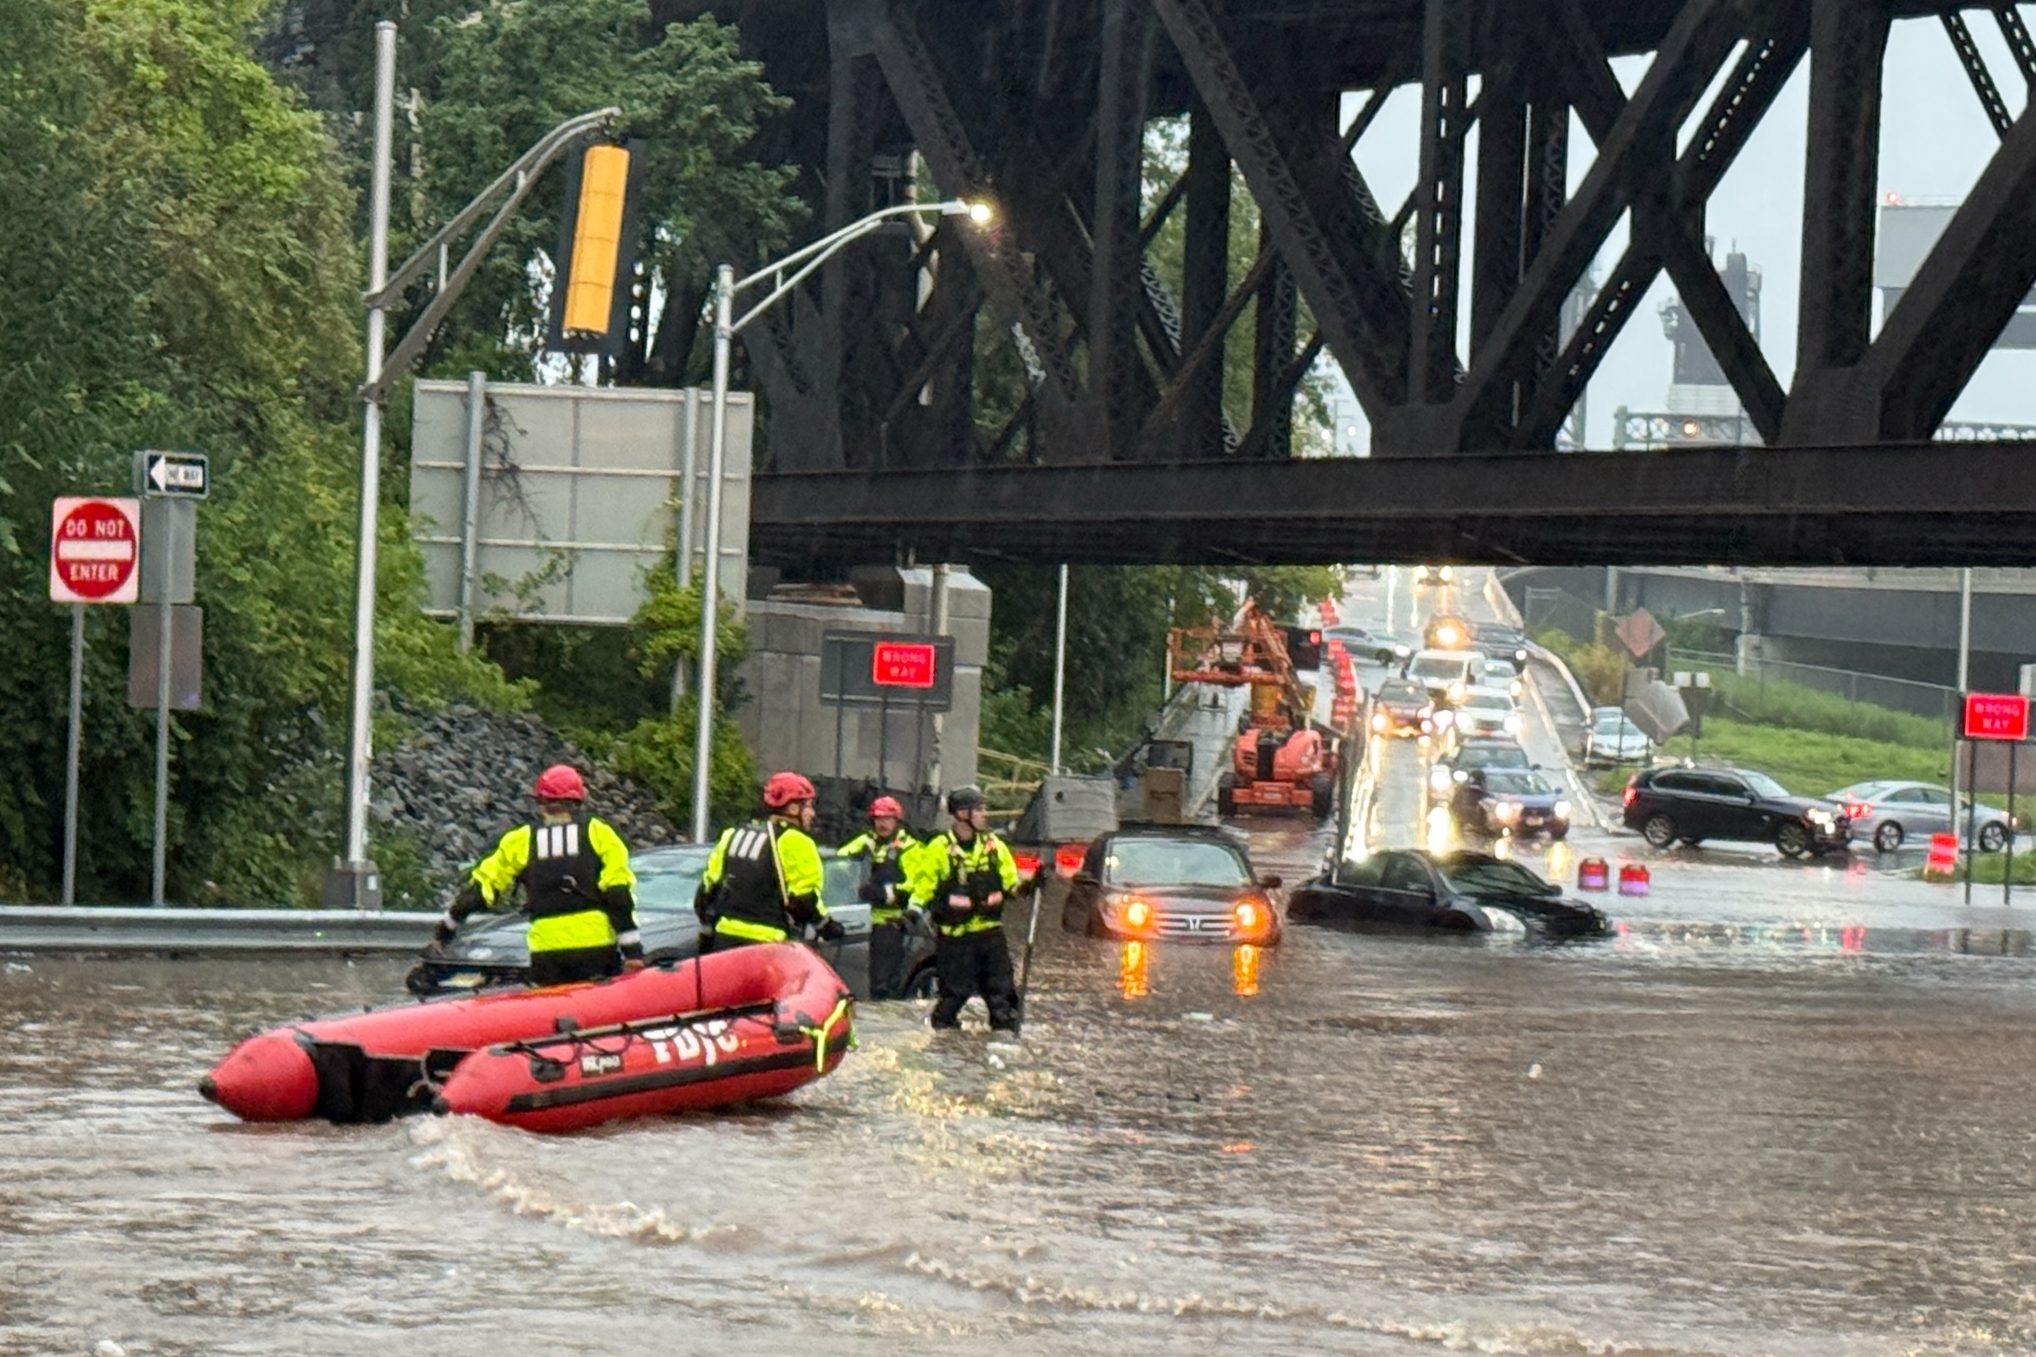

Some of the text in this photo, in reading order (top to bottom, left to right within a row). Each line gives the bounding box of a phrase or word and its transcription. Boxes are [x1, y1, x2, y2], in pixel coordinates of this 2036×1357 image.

[66, 519, 125, 538] DO NOT
[70, 563, 119, 582] ENTER
[882, 650, 926, 664] WRONG
[890, 666, 916, 678] WAY
[1974, 703, 2020, 717] WRONG
[1982, 718, 2010, 729] WAY
